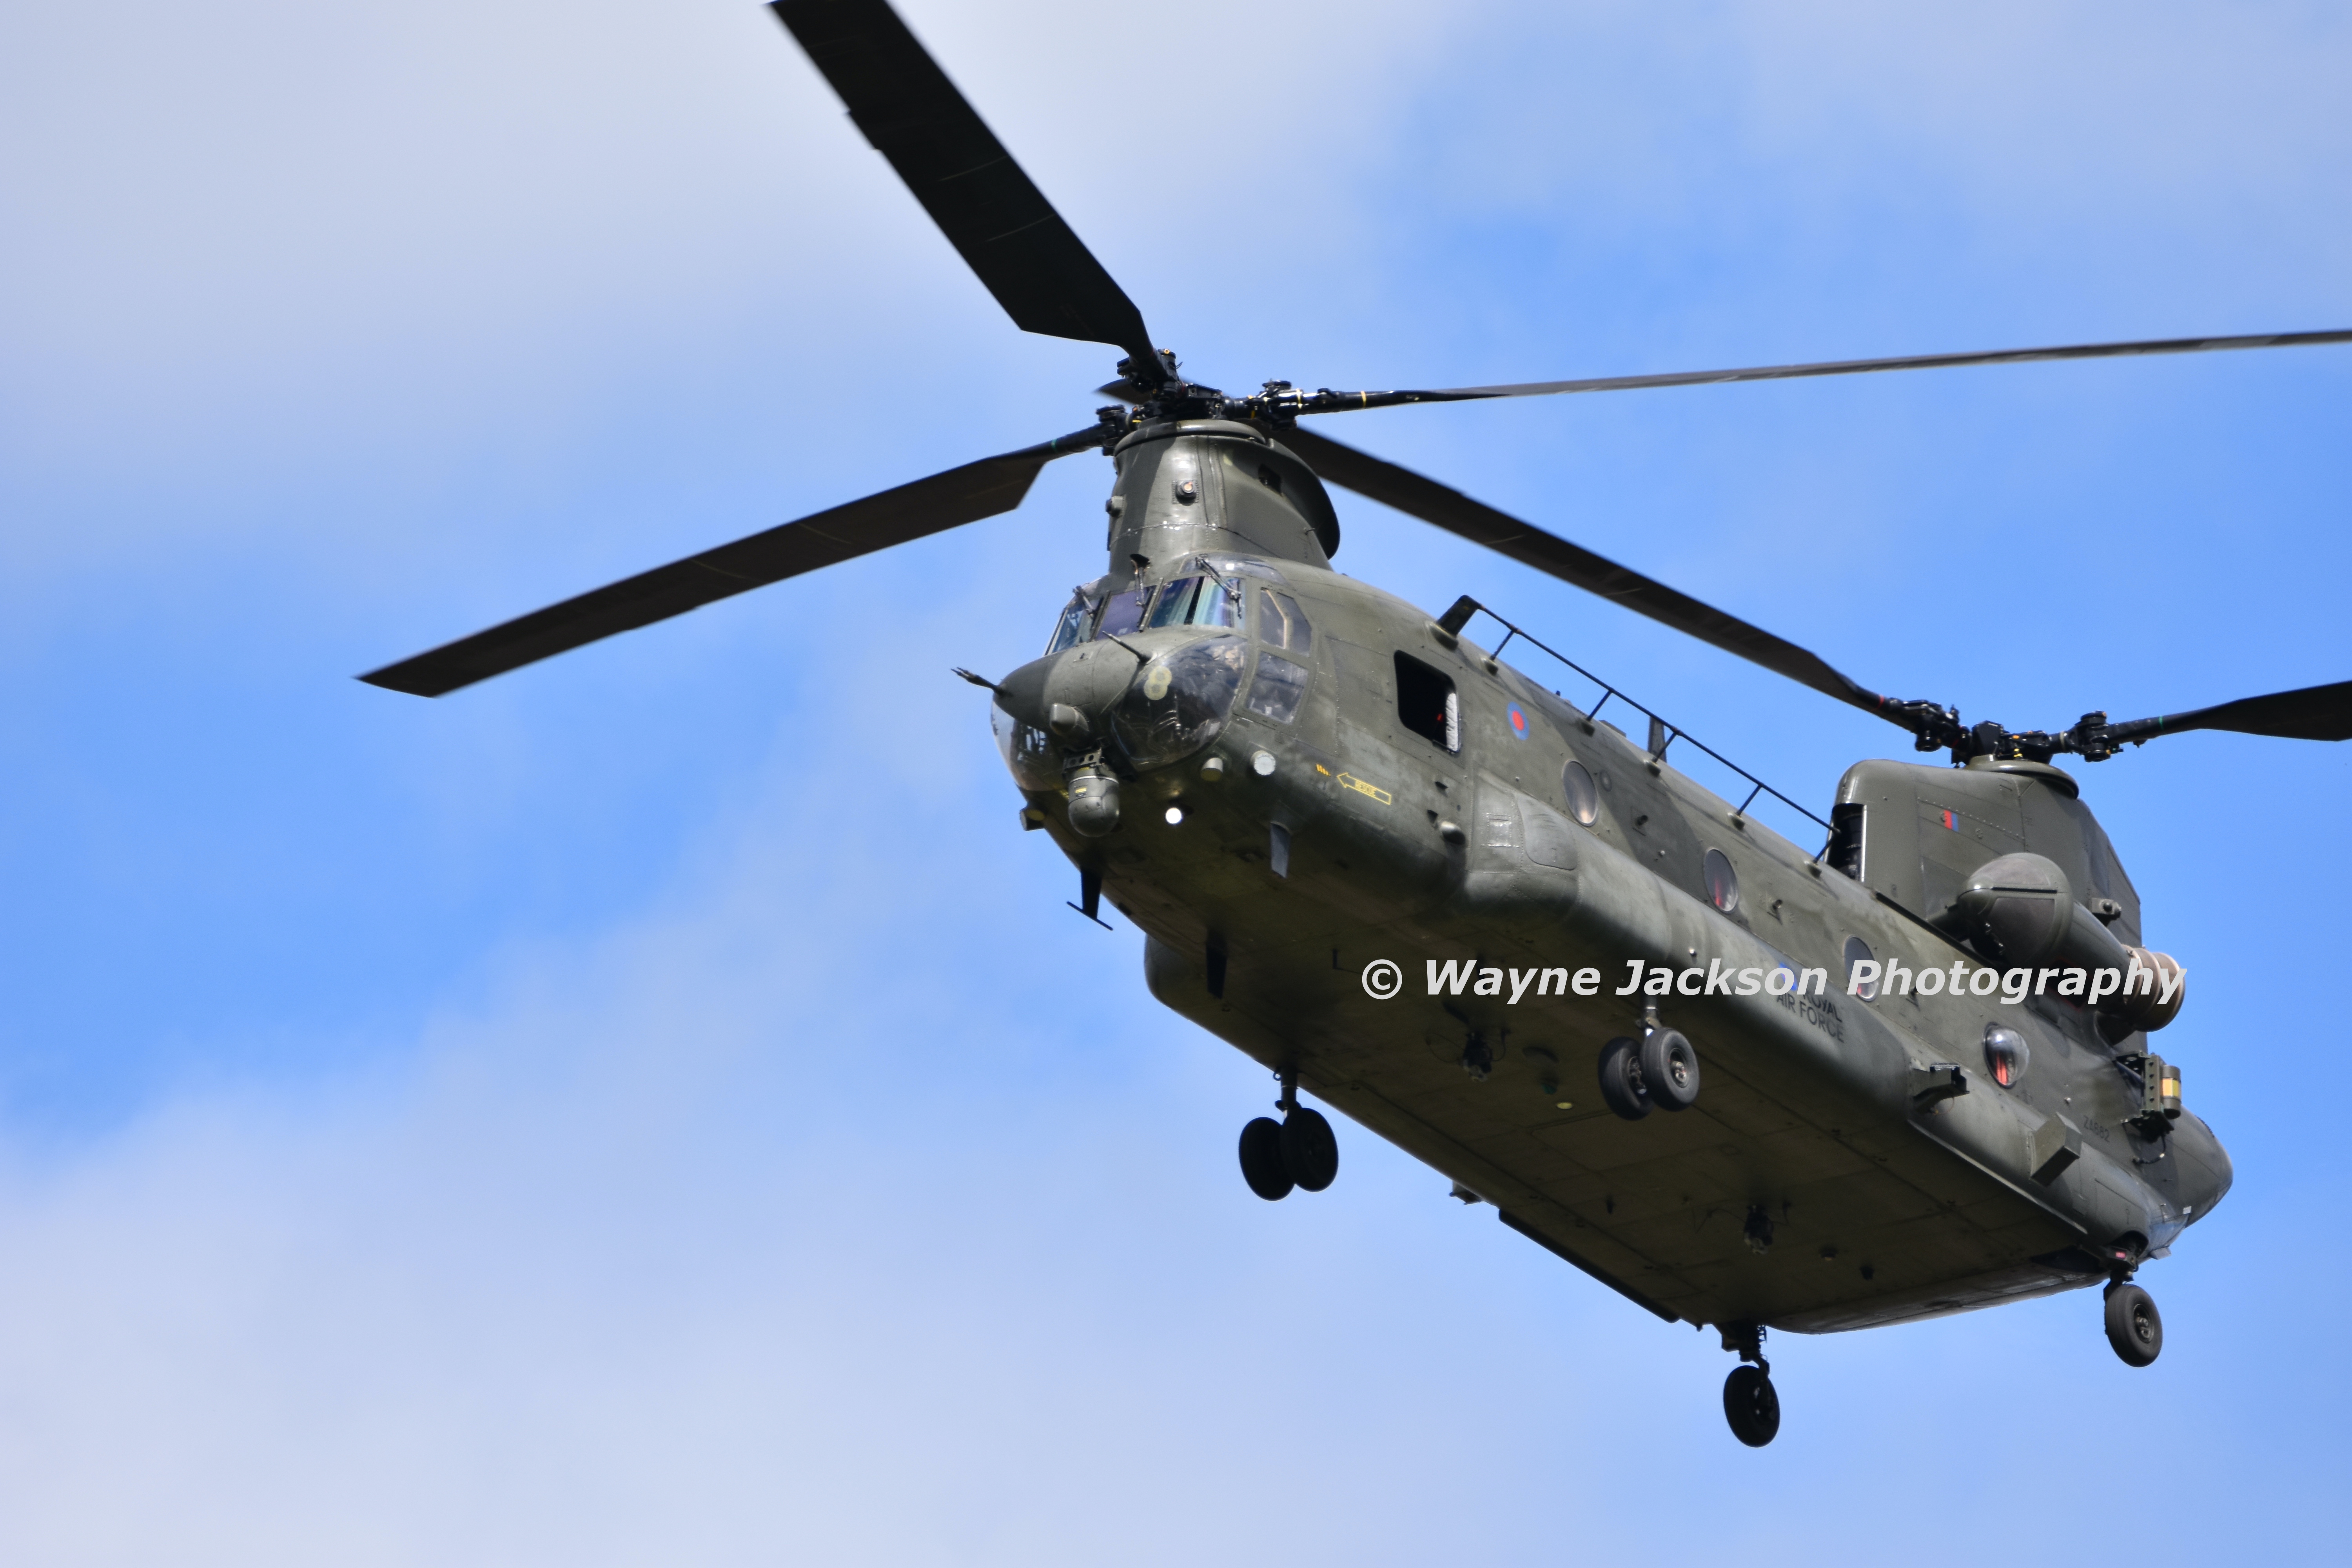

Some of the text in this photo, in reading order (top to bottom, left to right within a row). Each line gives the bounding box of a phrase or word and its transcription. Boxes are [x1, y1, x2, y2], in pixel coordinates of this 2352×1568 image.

[1355, 780, 1376, 797] RESCUE
[1777, 993, 1844, 1043] AIR FORCE
